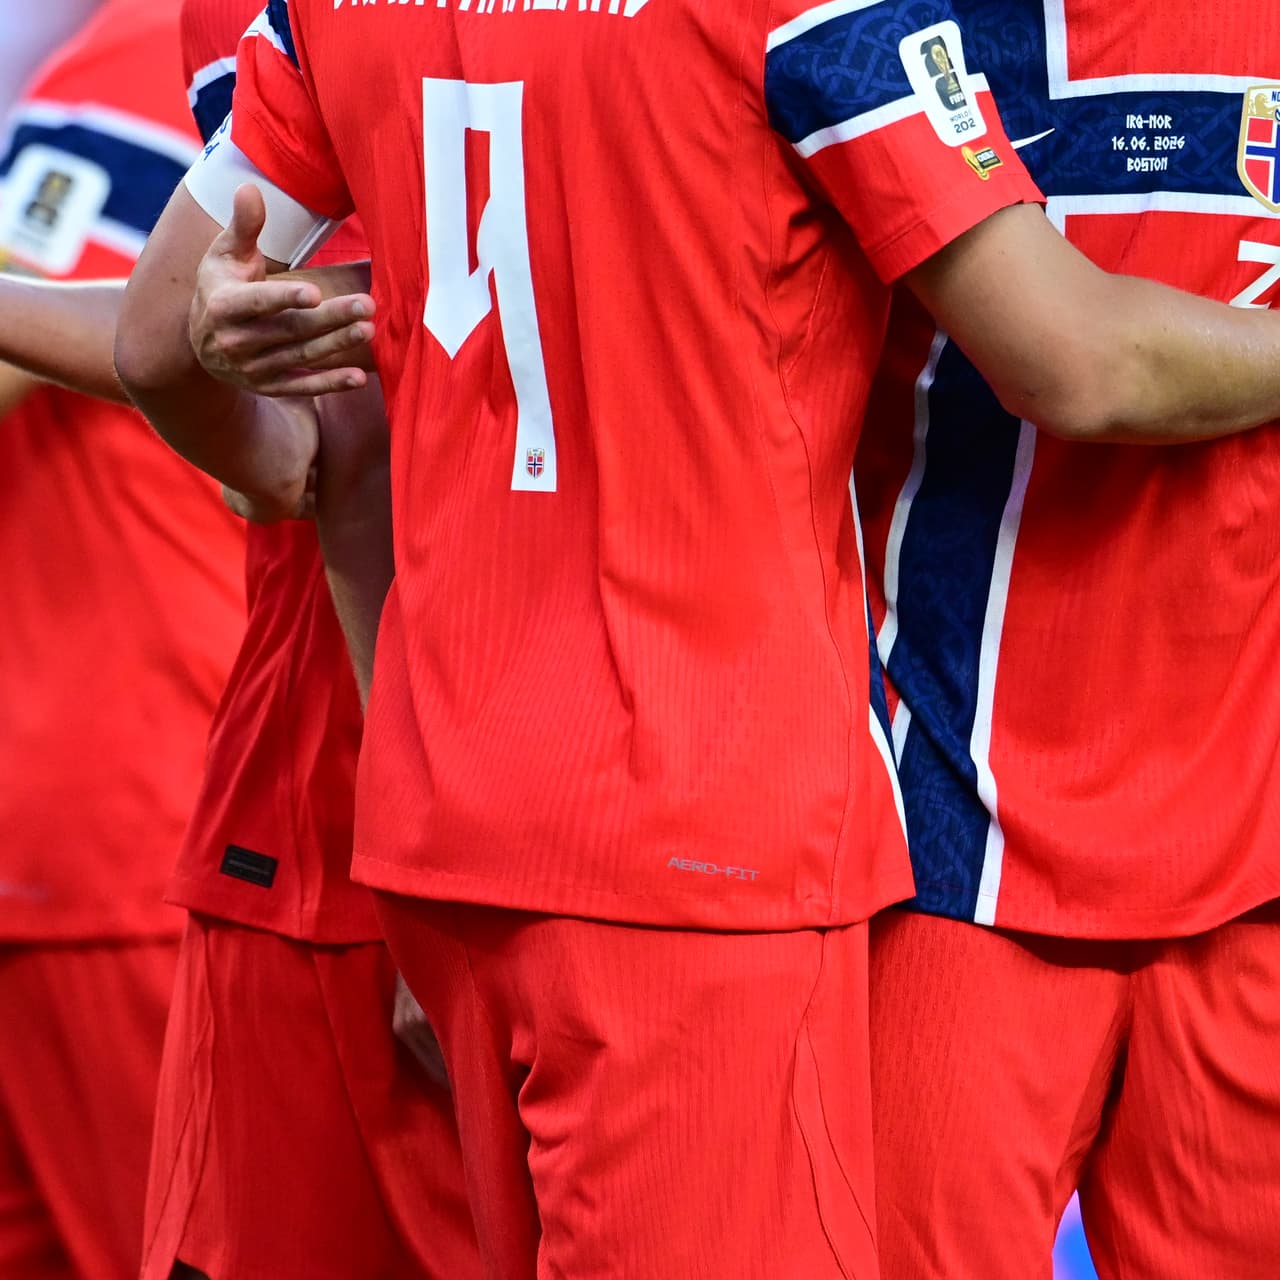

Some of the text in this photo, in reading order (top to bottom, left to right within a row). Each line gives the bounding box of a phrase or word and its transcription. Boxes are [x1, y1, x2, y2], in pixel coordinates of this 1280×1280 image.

[953, 117, 977, 134] 202
[1125, 114, 1173, 130] IRQ-NOR
[1126, 156, 1169, 172] BOSTON
[422, 76, 557, 492] 9
[666, 856, 760, 881] AERO-FIT
